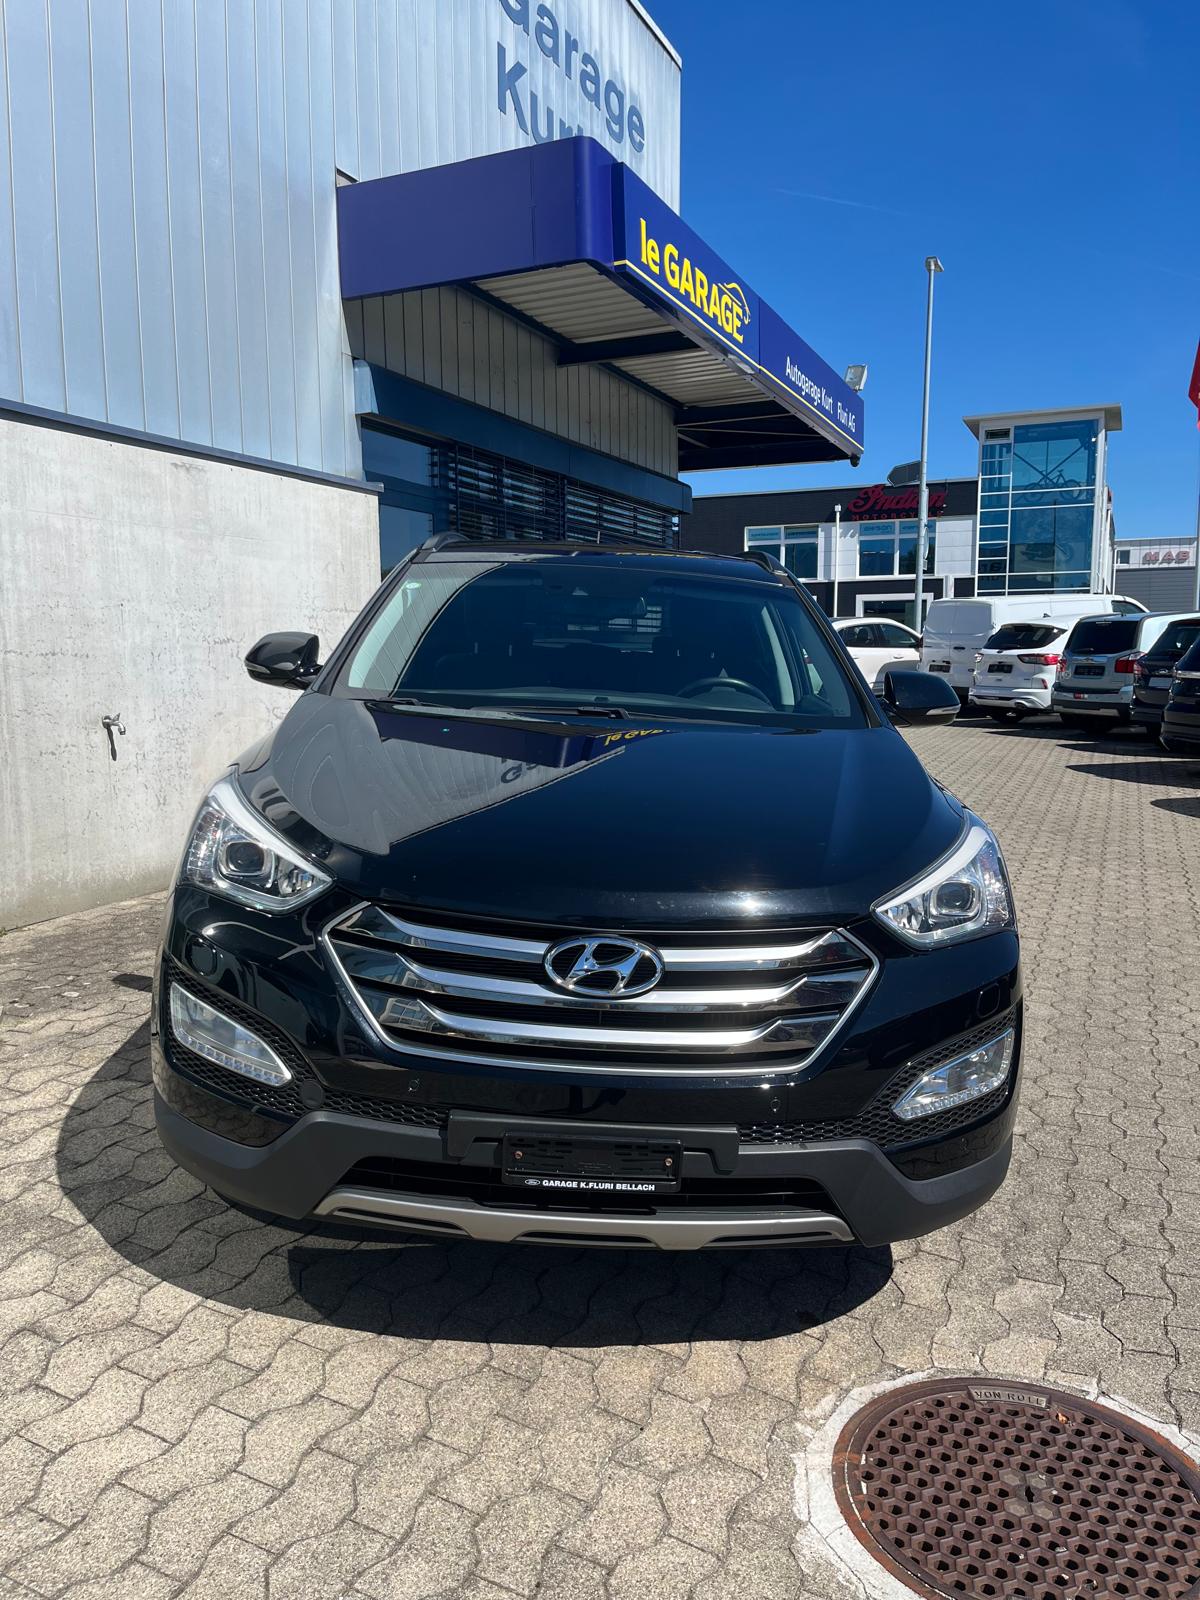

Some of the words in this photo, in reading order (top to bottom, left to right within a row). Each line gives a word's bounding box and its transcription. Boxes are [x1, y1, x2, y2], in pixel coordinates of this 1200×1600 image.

[497, 41, 584, 144] Ku
[639, 217, 660, 276] le
[663, 243, 744, 344] GARAGE
[786, 356, 820, 406] Autogarage
[821, 387, 833, 414] Kurt
[848, 412, 856, 433] AG
[848, 484, 946, 512] Indin
[1142, 550, 1191, 565] MAB
[542, 1179, 578, 1188] GARAGE
[580, 1181, 614, 1190] K.FLURI
[615, 1183, 655, 1191] BELLACH
[974, 1390, 1001, 1399] VON
